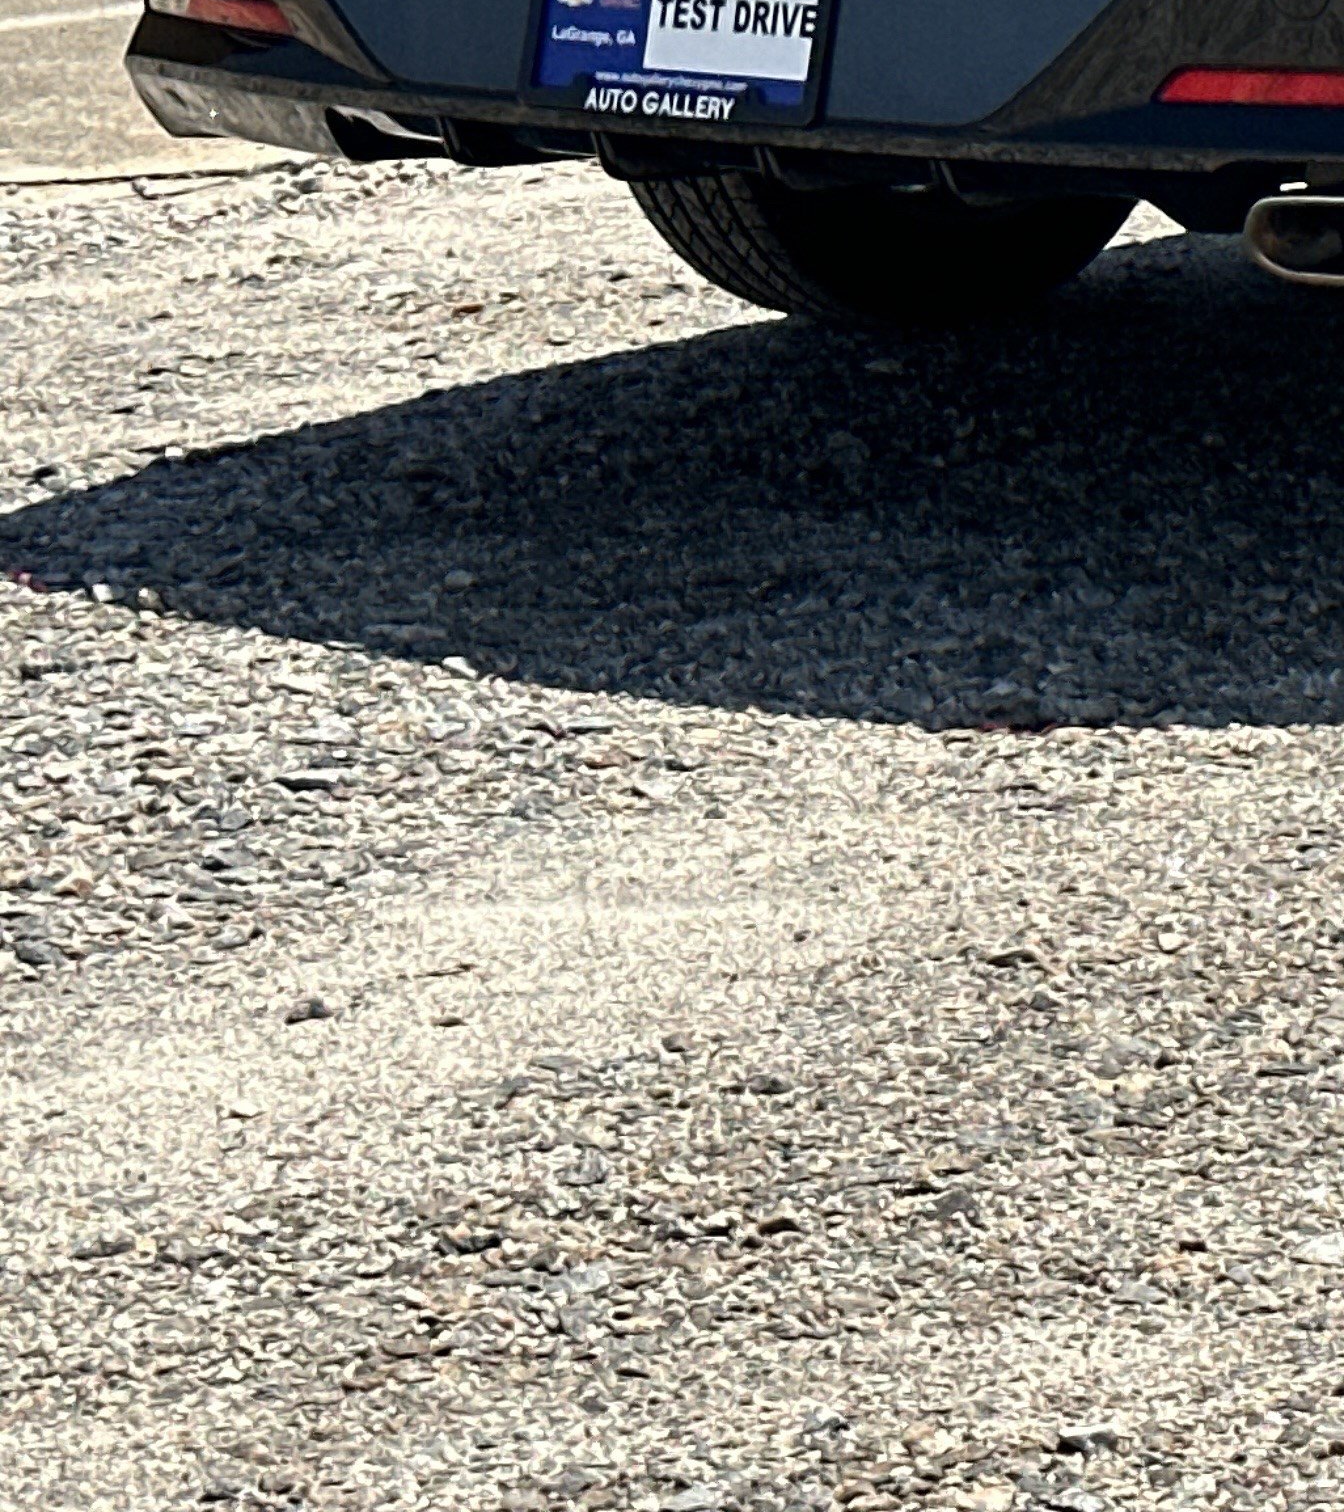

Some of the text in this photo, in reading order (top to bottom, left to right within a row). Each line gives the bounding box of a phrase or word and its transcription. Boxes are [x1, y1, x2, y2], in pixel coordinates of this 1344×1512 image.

[732, 0, 819, 39] DRIVE
[616, 29, 636, 46] GA
[583, 87, 735, 120] AUTO GALLERY
